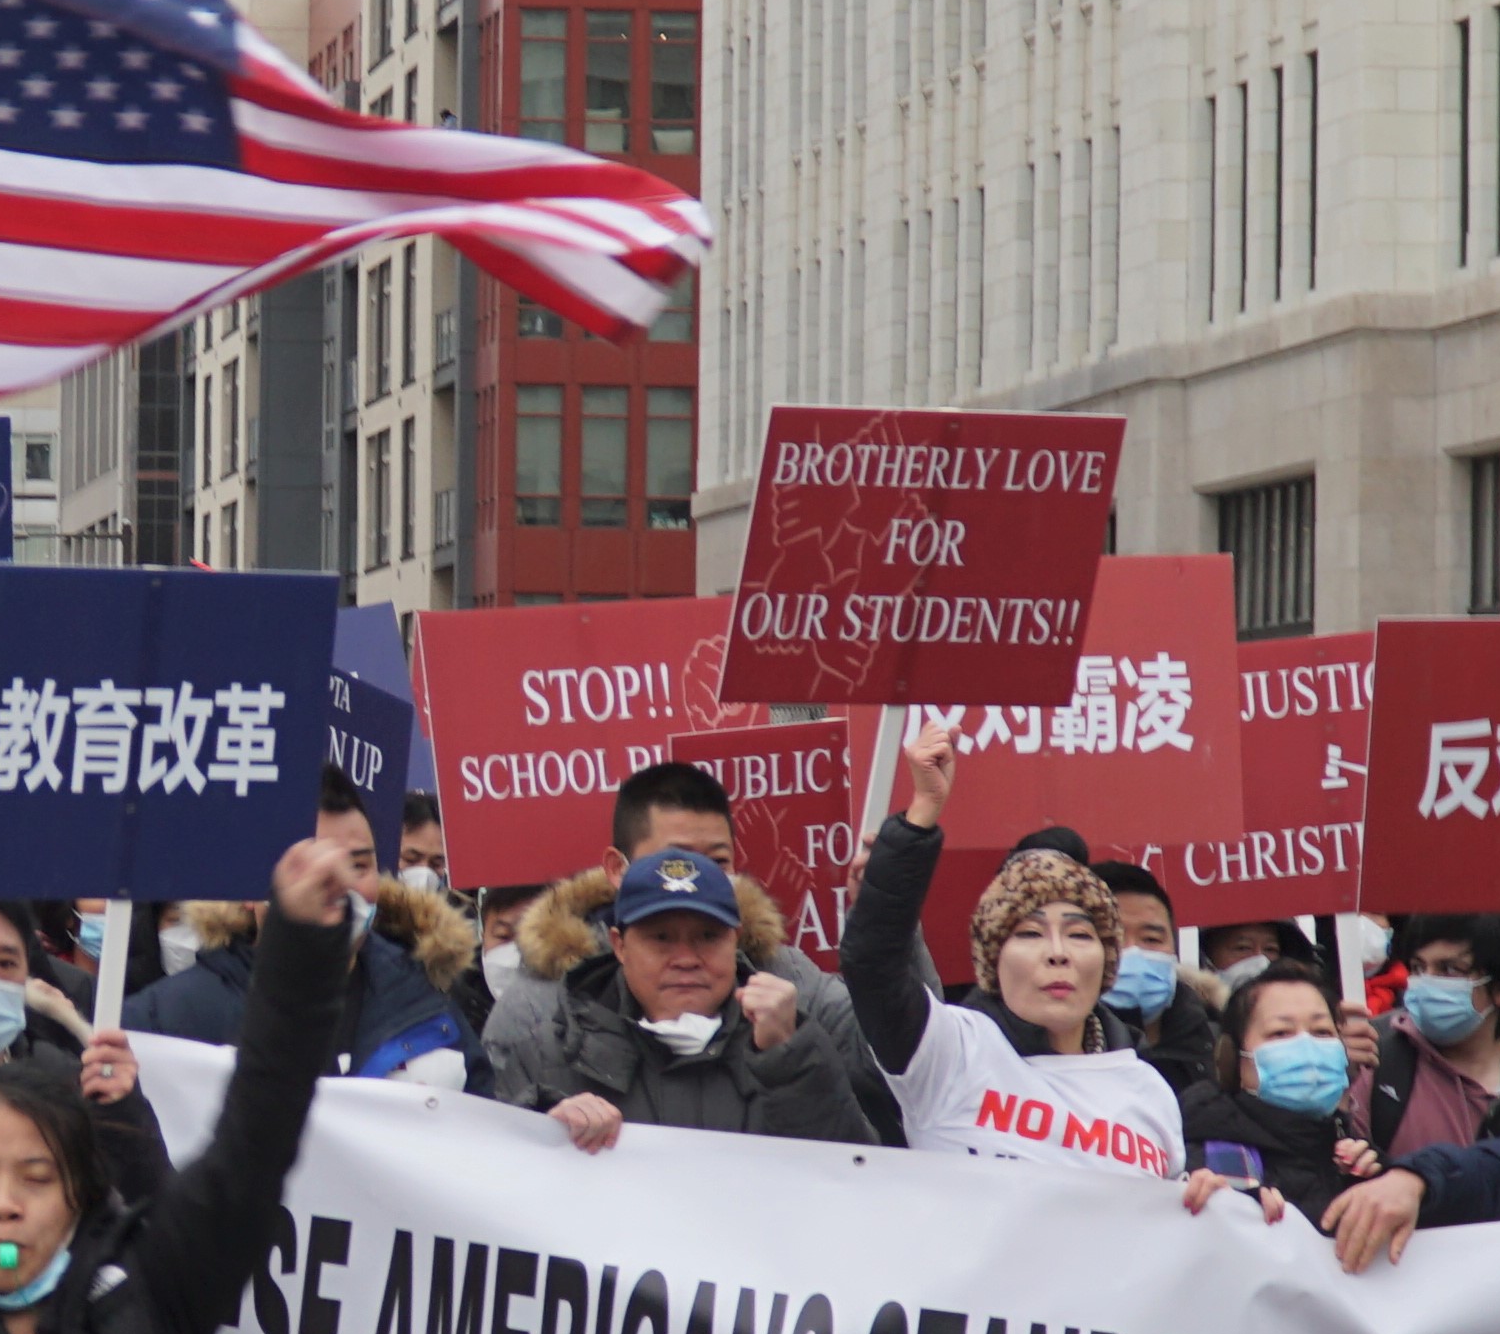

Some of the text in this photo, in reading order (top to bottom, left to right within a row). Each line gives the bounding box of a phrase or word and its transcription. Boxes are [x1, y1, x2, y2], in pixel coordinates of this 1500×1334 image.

[774, 441, 1106, 496] BROTHERLY LOVE
[884, 517, 966, 567] FOR
[740, 592, 1081, 648] OUR STUDENTS!!
[521, 661, 675, 727] STOP!!
[351, 735, 384, 793] UP
[460, 747, 622, 803] SCHOOL
[975, 1088, 1055, 1142] NO
